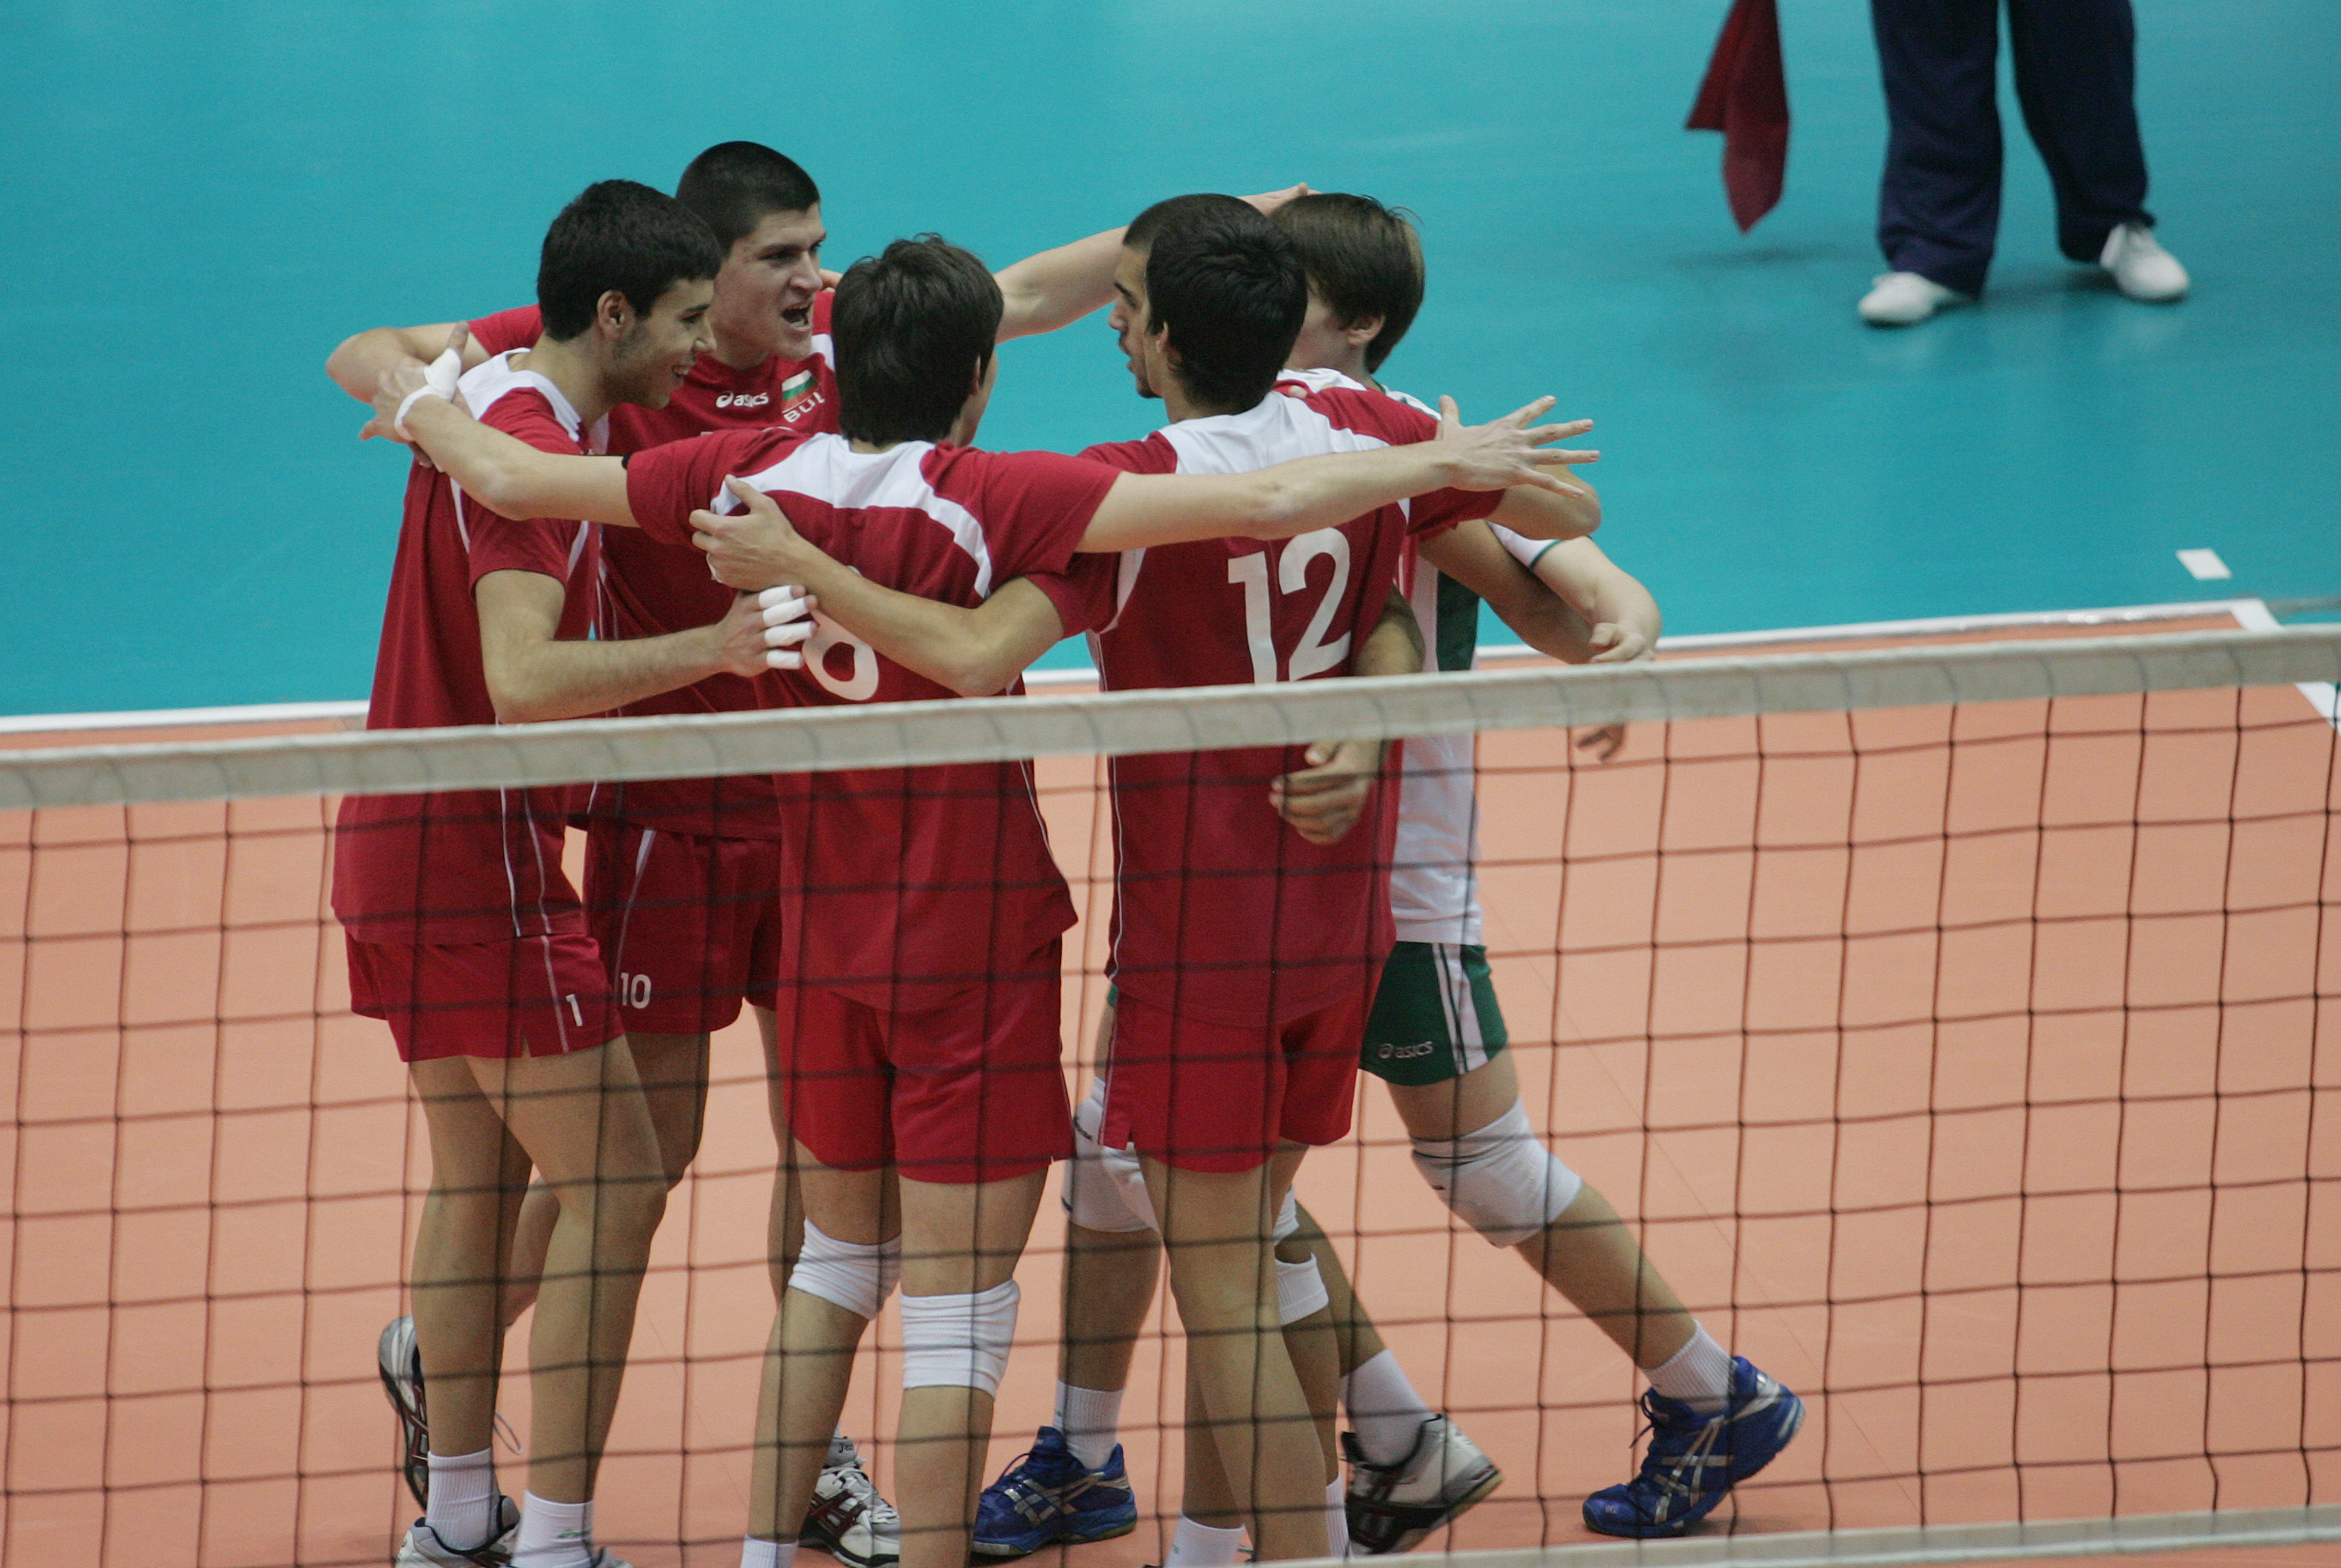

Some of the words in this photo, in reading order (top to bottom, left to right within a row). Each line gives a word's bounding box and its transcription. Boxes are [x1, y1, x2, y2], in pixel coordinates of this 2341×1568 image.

[733, 392, 769, 408] asics
[783, 391, 825, 422] BUL
[1228, 527, 1352, 686] 12
[620, 972, 652, 1009] 10
[565, 993, 584, 1027] 1
